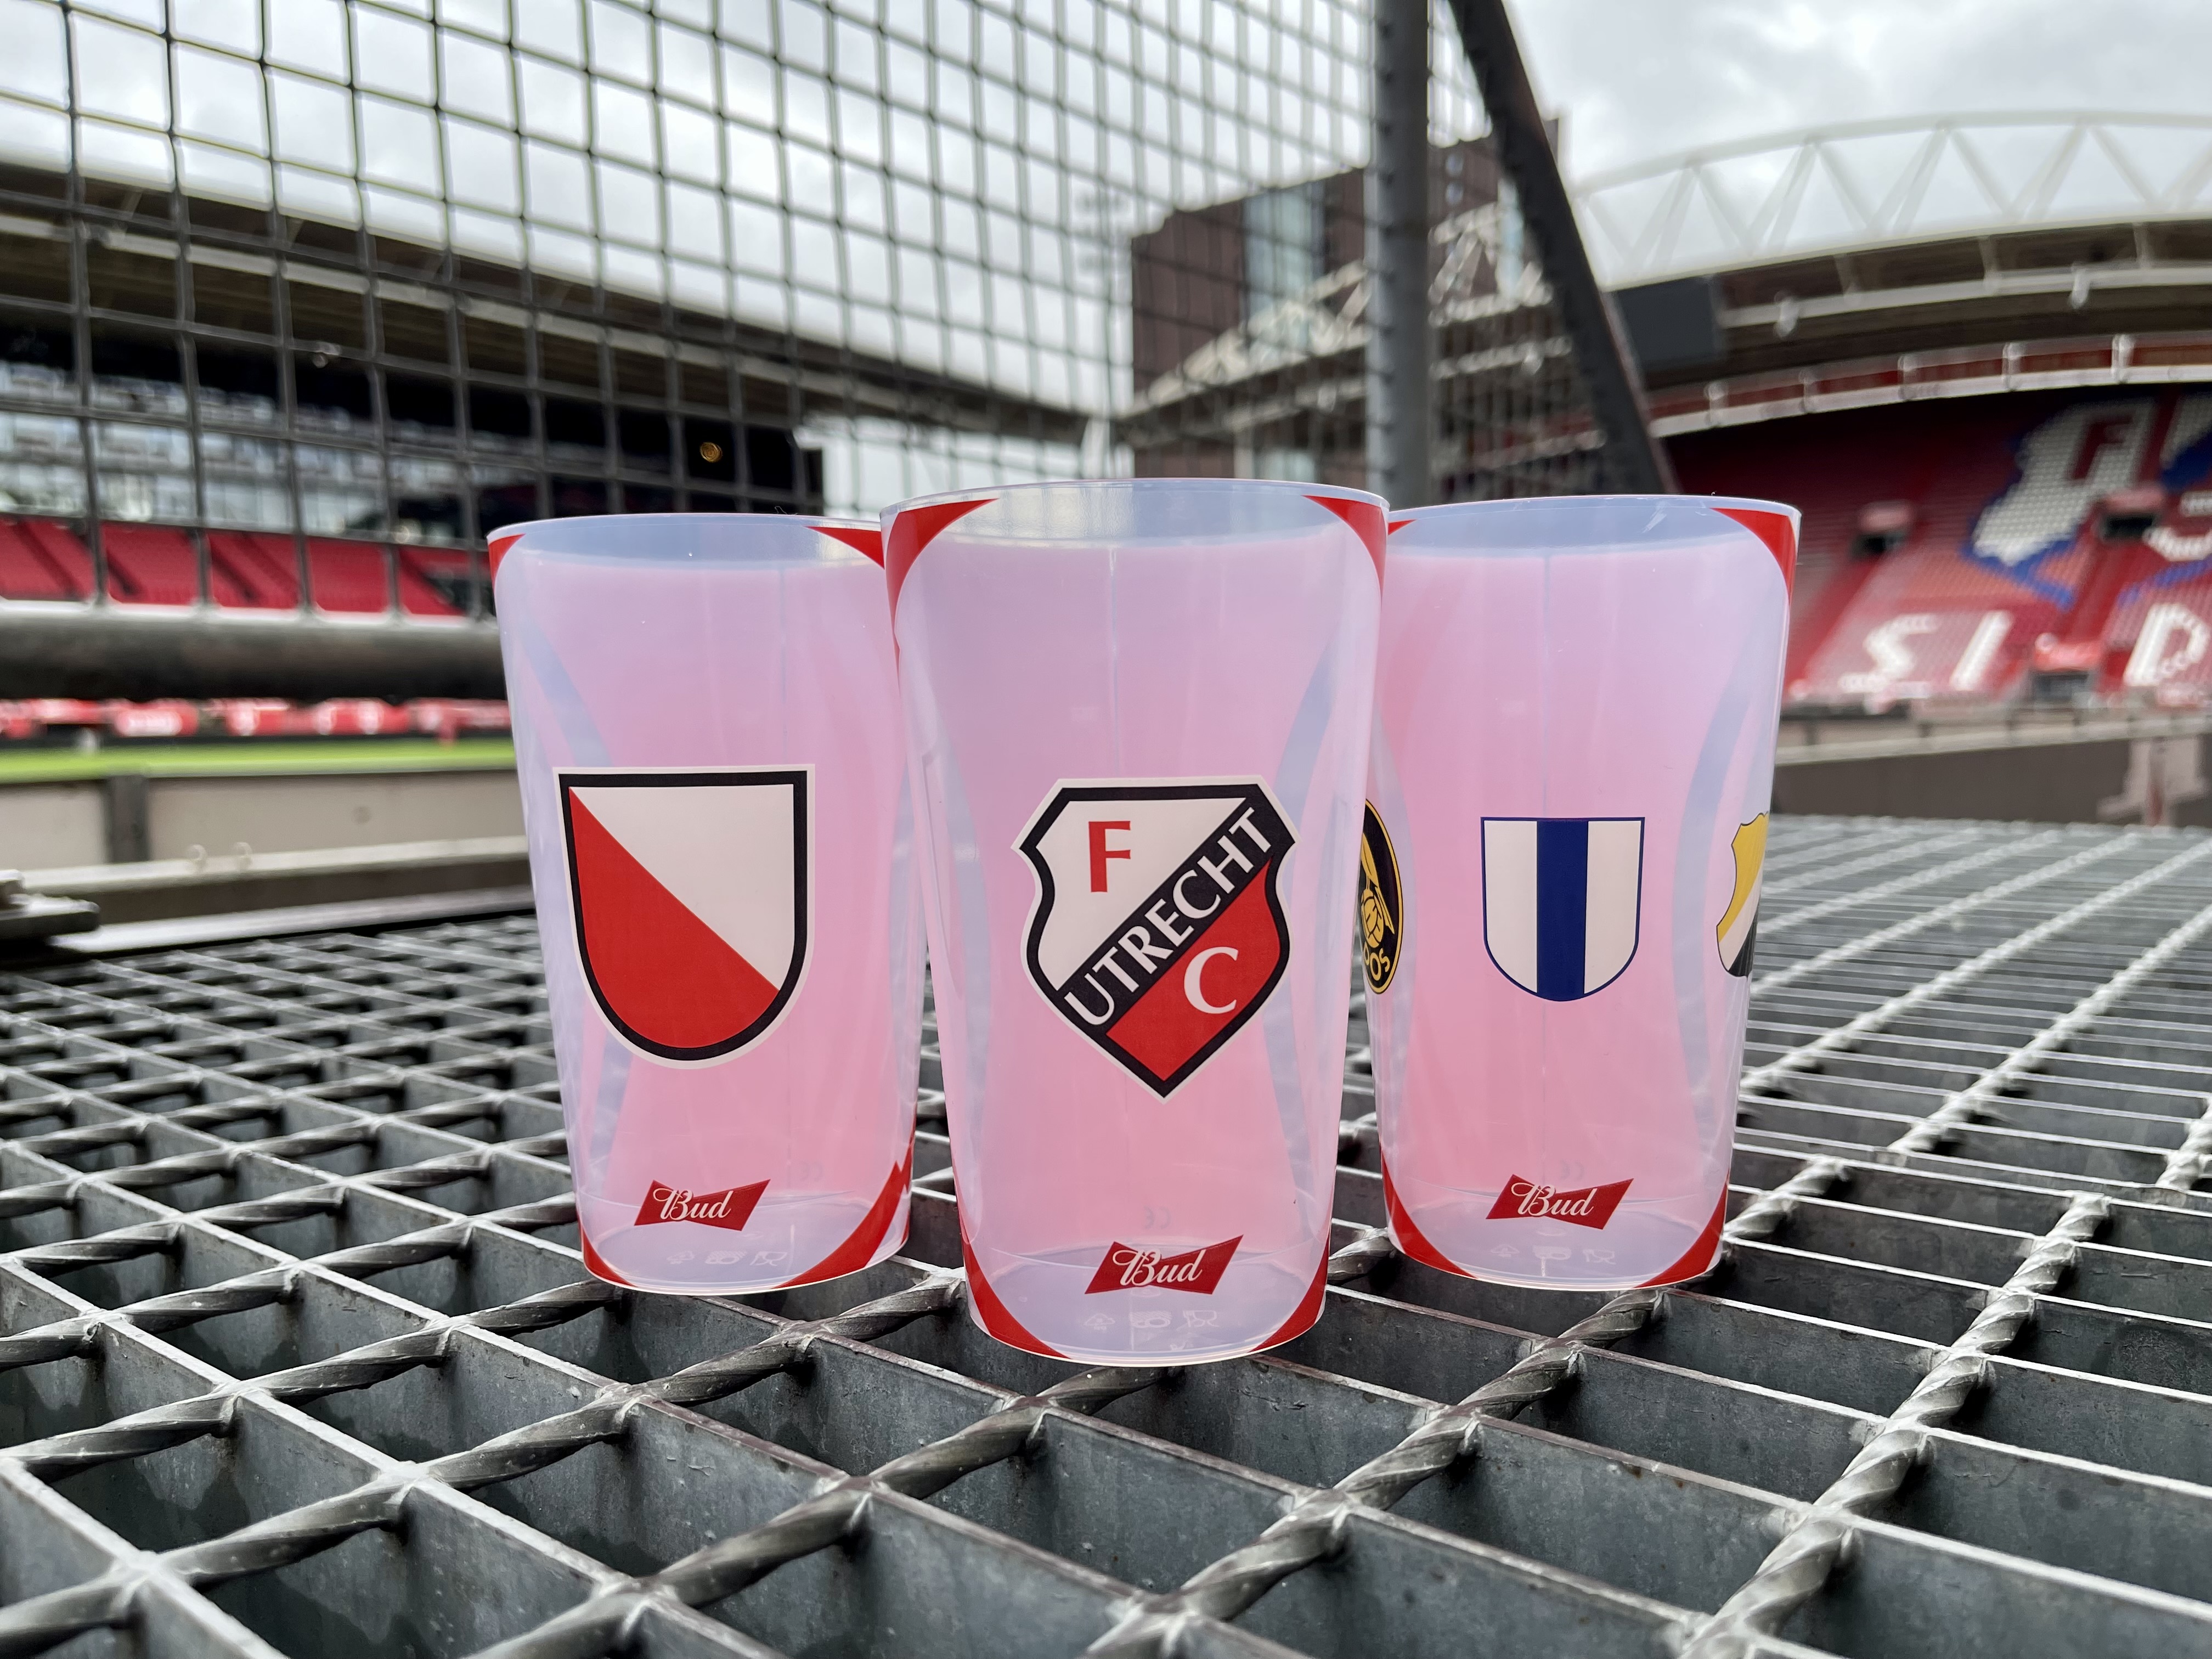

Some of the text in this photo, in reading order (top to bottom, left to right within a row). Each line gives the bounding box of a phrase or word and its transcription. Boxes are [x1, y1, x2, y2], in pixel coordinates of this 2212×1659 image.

[1088, 821, 1131, 893] F
[1064, 806, 1272, 1025] UTRECHT
[1184, 946, 1239, 1014] C
[653, 1188, 734, 1221] Bud
[1511, 1182, 1598, 1216] Bud
[1112, 1248, 1206, 1286] Bud
